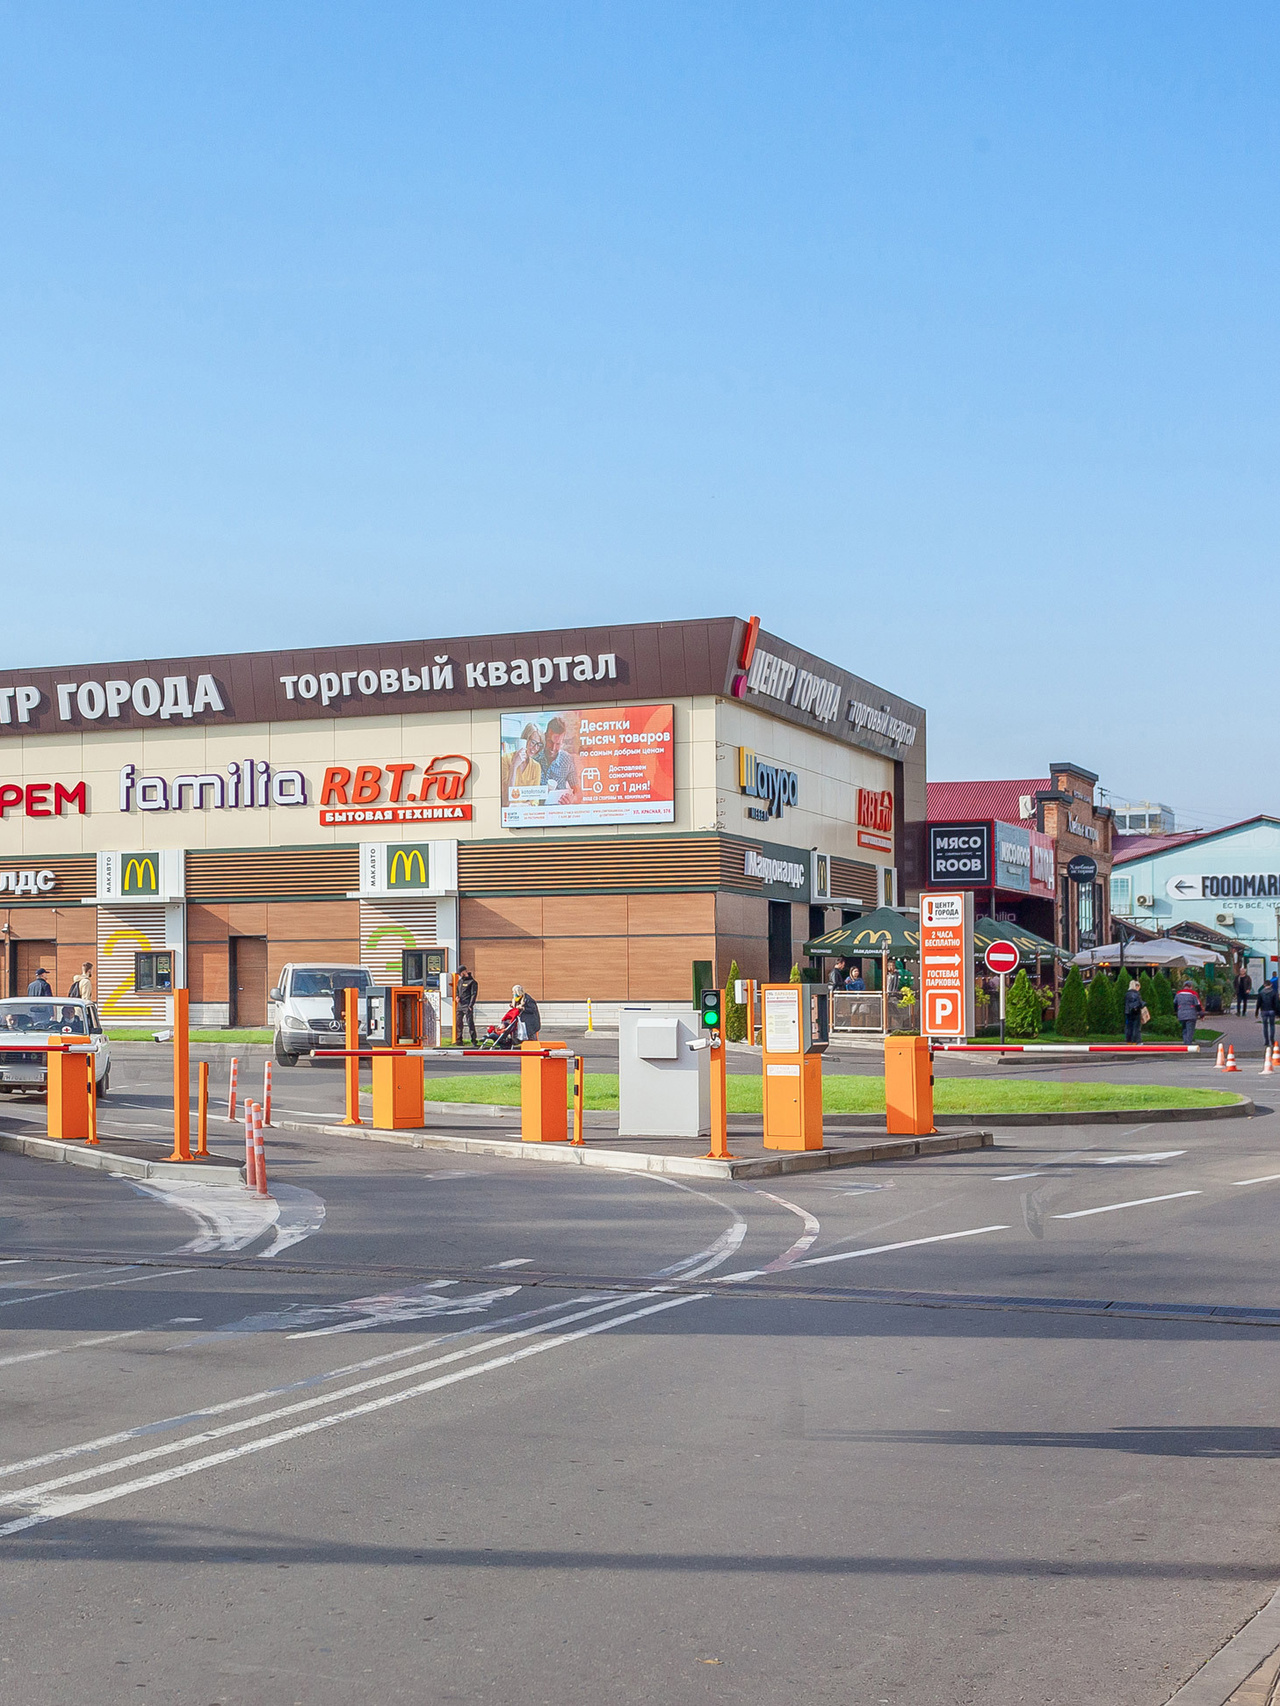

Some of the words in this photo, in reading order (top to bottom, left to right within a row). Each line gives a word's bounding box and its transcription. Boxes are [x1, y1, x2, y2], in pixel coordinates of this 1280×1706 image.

[56, 674, 226, 721] ГОРОДА
[280, 655, 455, 706] торговый
[466, 652, 617, 693] квартал
[747, 648, 796, 702] ЦЕНТР
[791, 668, 841, 724] ГОРОДА
[579, 719, 630, 734] Десятки
[579, 735, 617, 746] тысяч
[618, 732, 671, 745] товаров
[589, 749, 613, 757] самым
[613, 747, 641, 757] добрым
[642, 747, 665, 755] ценам
[608, 764, 647, 773] Доставляем
[120, 758, 307, 812] familia
[320, 756, 471, 806] RBT.ru
[608, 783, 621, 792] от
[622, 781, 627, 791] 1
[629, 780, 651, 792] дня!
[740, 746, 798, 819] Шатура
[325, 809, 393, 823] БЫТОВАЯ
[397, 806, 463, 821] ТЕХНИКА
[935, 836, 981, 849] МЯСО
[936, 859, 982, 872] ROOB
[1201, 874, 1280, 898] FOODMAR
[934, 901, 954, 909] ЦЕНТР
[934, 908, 960, 916] ГОРОДА
[931, 930, 937, 939] 2
[937, 930, 953, 938] ЧАСА
[924, 938, 961, 947] БЕСПЛАТНО
[927, 969, 959, 978] ГОСТЕВАЯ
[925, 977, 961, 987] ПАРКОВКА
[935, 998, 953, 1025] P
